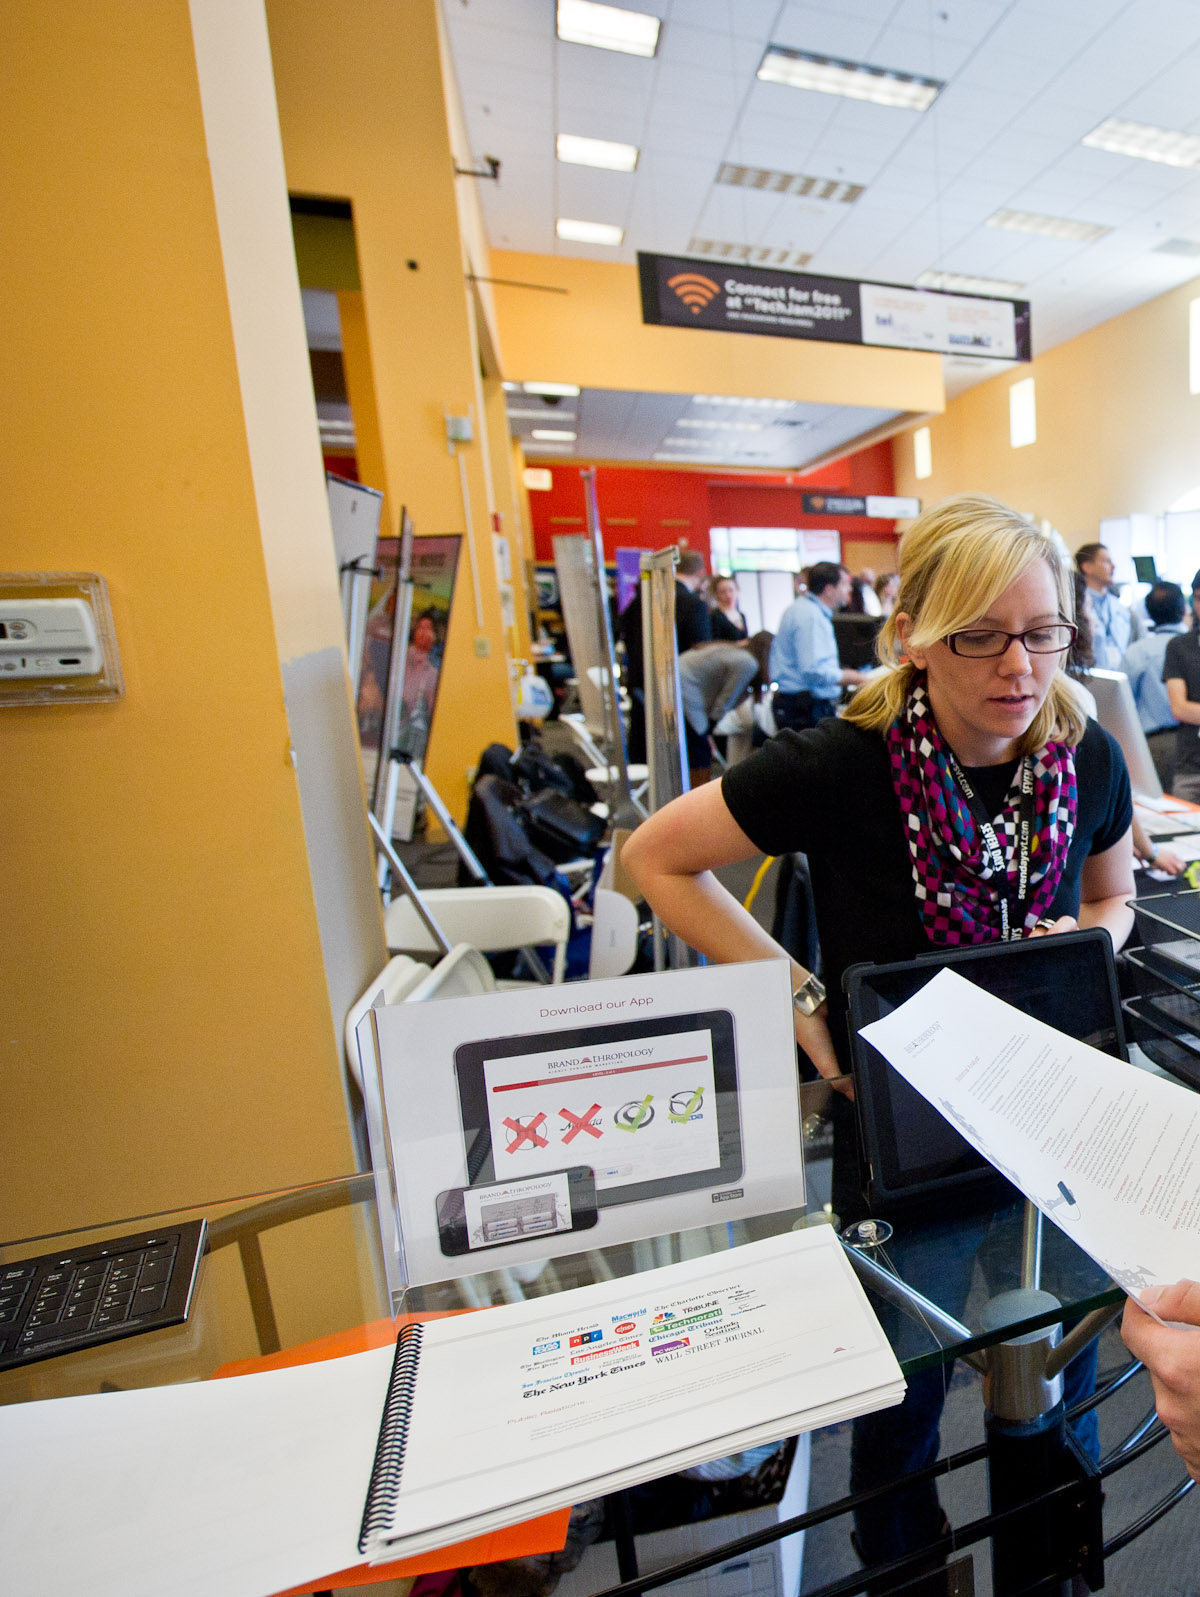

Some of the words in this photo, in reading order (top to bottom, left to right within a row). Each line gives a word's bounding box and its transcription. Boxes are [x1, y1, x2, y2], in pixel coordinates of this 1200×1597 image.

[724, 279, 787, 300] Connect
[788, 286, 810, 304] for
[812, 289, 842, 307] free
[725, 295, 742, 310] at
[980, 822, 1000, 851] SEVEN
[991, 848, 1006, 873] DAYS
[539, 1002, 603, 1018] Download
[606, 1000, 627, 1009] our
[629, 997, 654, 1007] App
[547, 1058, 580, 1070] BRAND
[611, 1308, 647, 1322] Macworld
[665, 1309, 722, 1329] Technorati
[648, 1329, 686, 1342] Chicago
[687, 1318, 723, 1332] Tribune
[703, 1321, 740, 1334] Orlando
[705, 1325, 740, 1337] Sentinel
[574, 1341, 638, 1364] BusinessWeek
[655, 1352, 683, 1365] WALL
[685, 1338, 722, 1356] STREET
[724, 1326, 765, 1344] JOURNAL
[522, 1388, 546, 1399] The
[548, 1379, 575, 1393] New
[577, 1370, 608, 1385] York
[609, 1360, 647, 1375] Times
